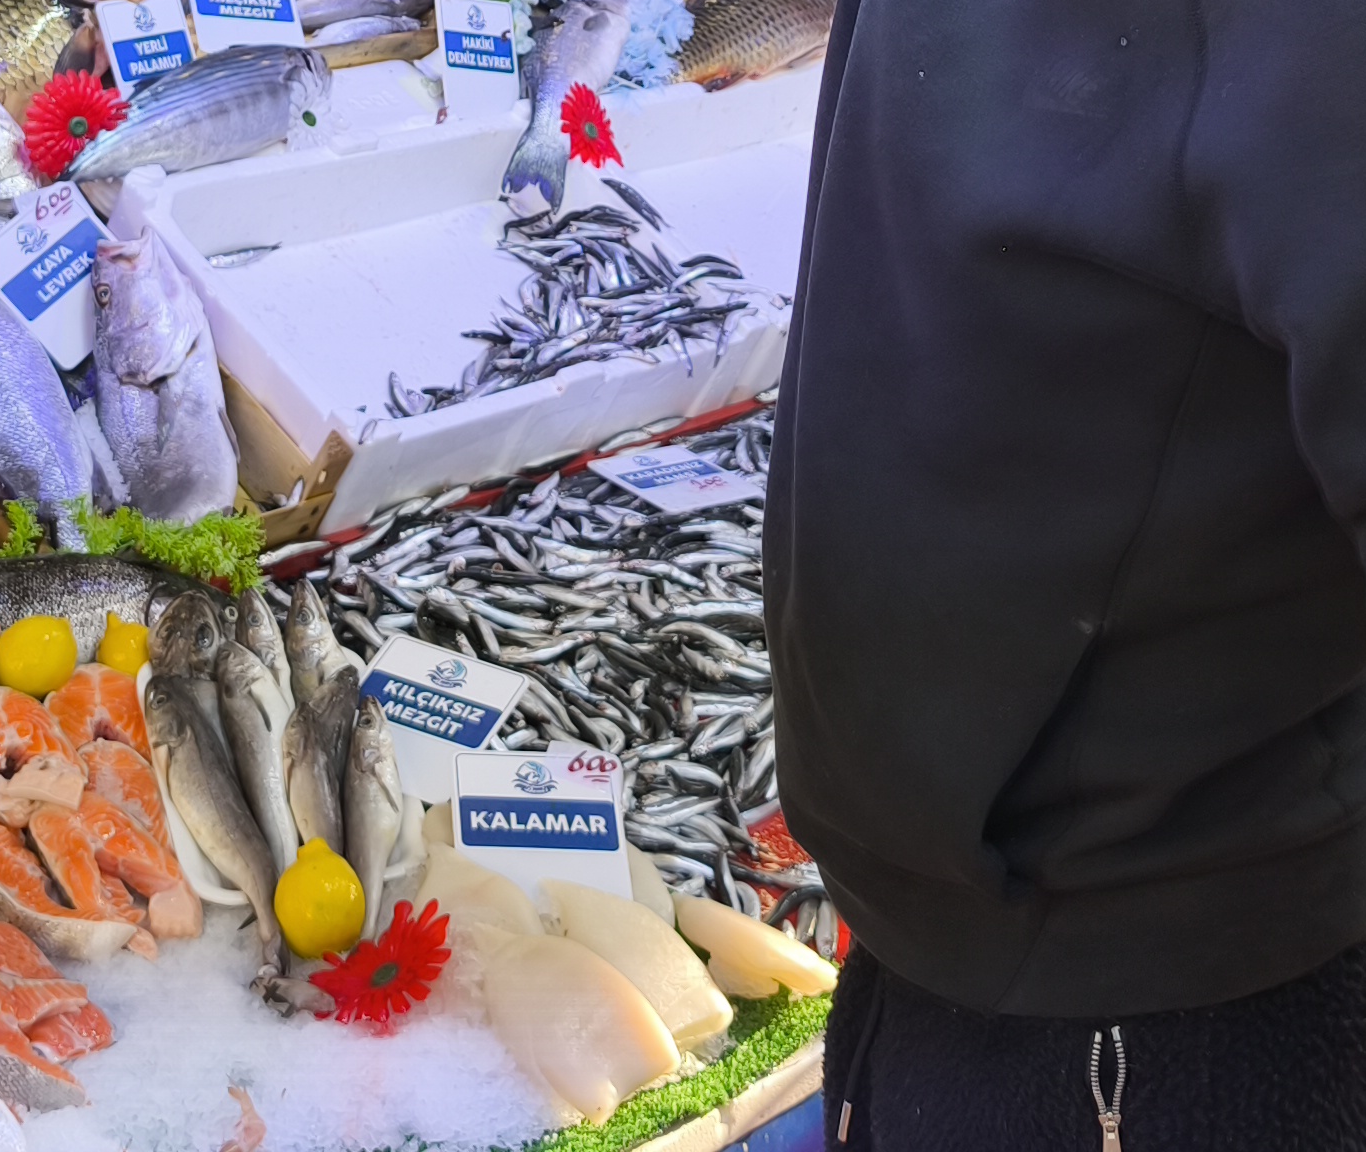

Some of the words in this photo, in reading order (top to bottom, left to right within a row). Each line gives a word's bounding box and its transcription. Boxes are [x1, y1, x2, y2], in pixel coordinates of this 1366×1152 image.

[219, 5, 276, 20] MEZGİT
[134, 35, 169, 56] YERLİ
[448, 49, 477, 66] DENİZ
[477, 53, 512, 70] LEVREK
[129, 54, 182, 77] PALAMUT
[35, 186, 72, 221] 600
[32, 245, 74, 281] KAYA
[37, 251, 94, 303] LEVREK
[383, 679, 486, 724] KILÇIKSIZ
[383, 700, 464, 737] MEZGİT
[469, 810, 609, 834] KALAMAR
